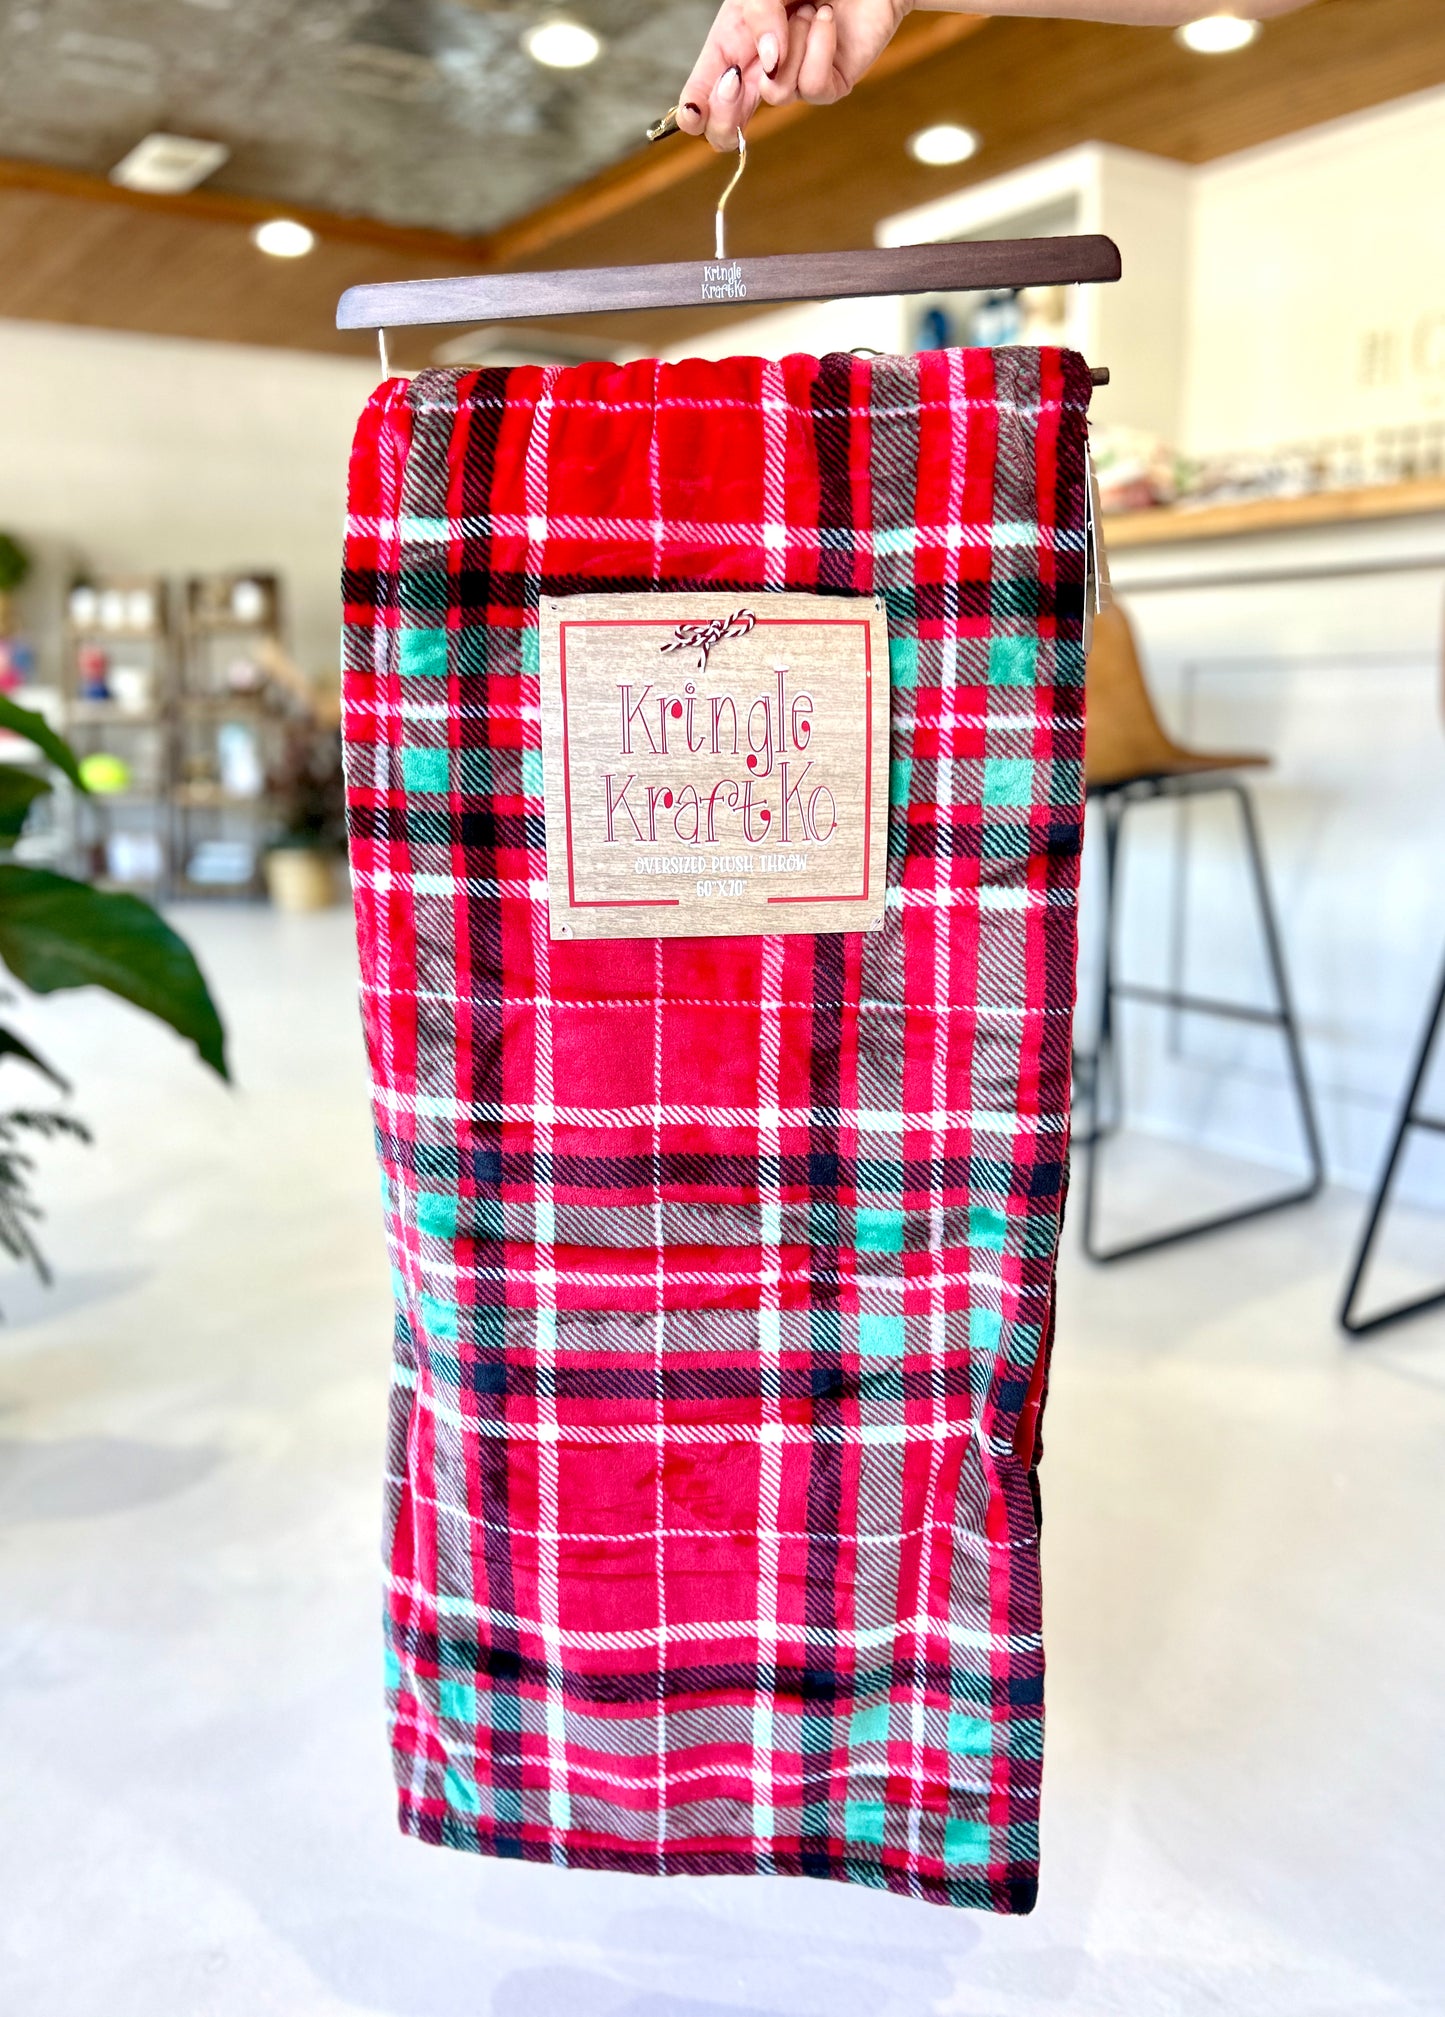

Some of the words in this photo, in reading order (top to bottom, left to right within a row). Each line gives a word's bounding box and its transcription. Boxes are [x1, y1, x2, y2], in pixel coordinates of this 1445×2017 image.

[704, 262, 742, 284] Kringle
[616, 667, 814, 778] Kringle
[634, 855, 707, 875] OVERSIZED
[711, 855, 754, 874] PLUSH
[759, 853, 808, 873] THROW
